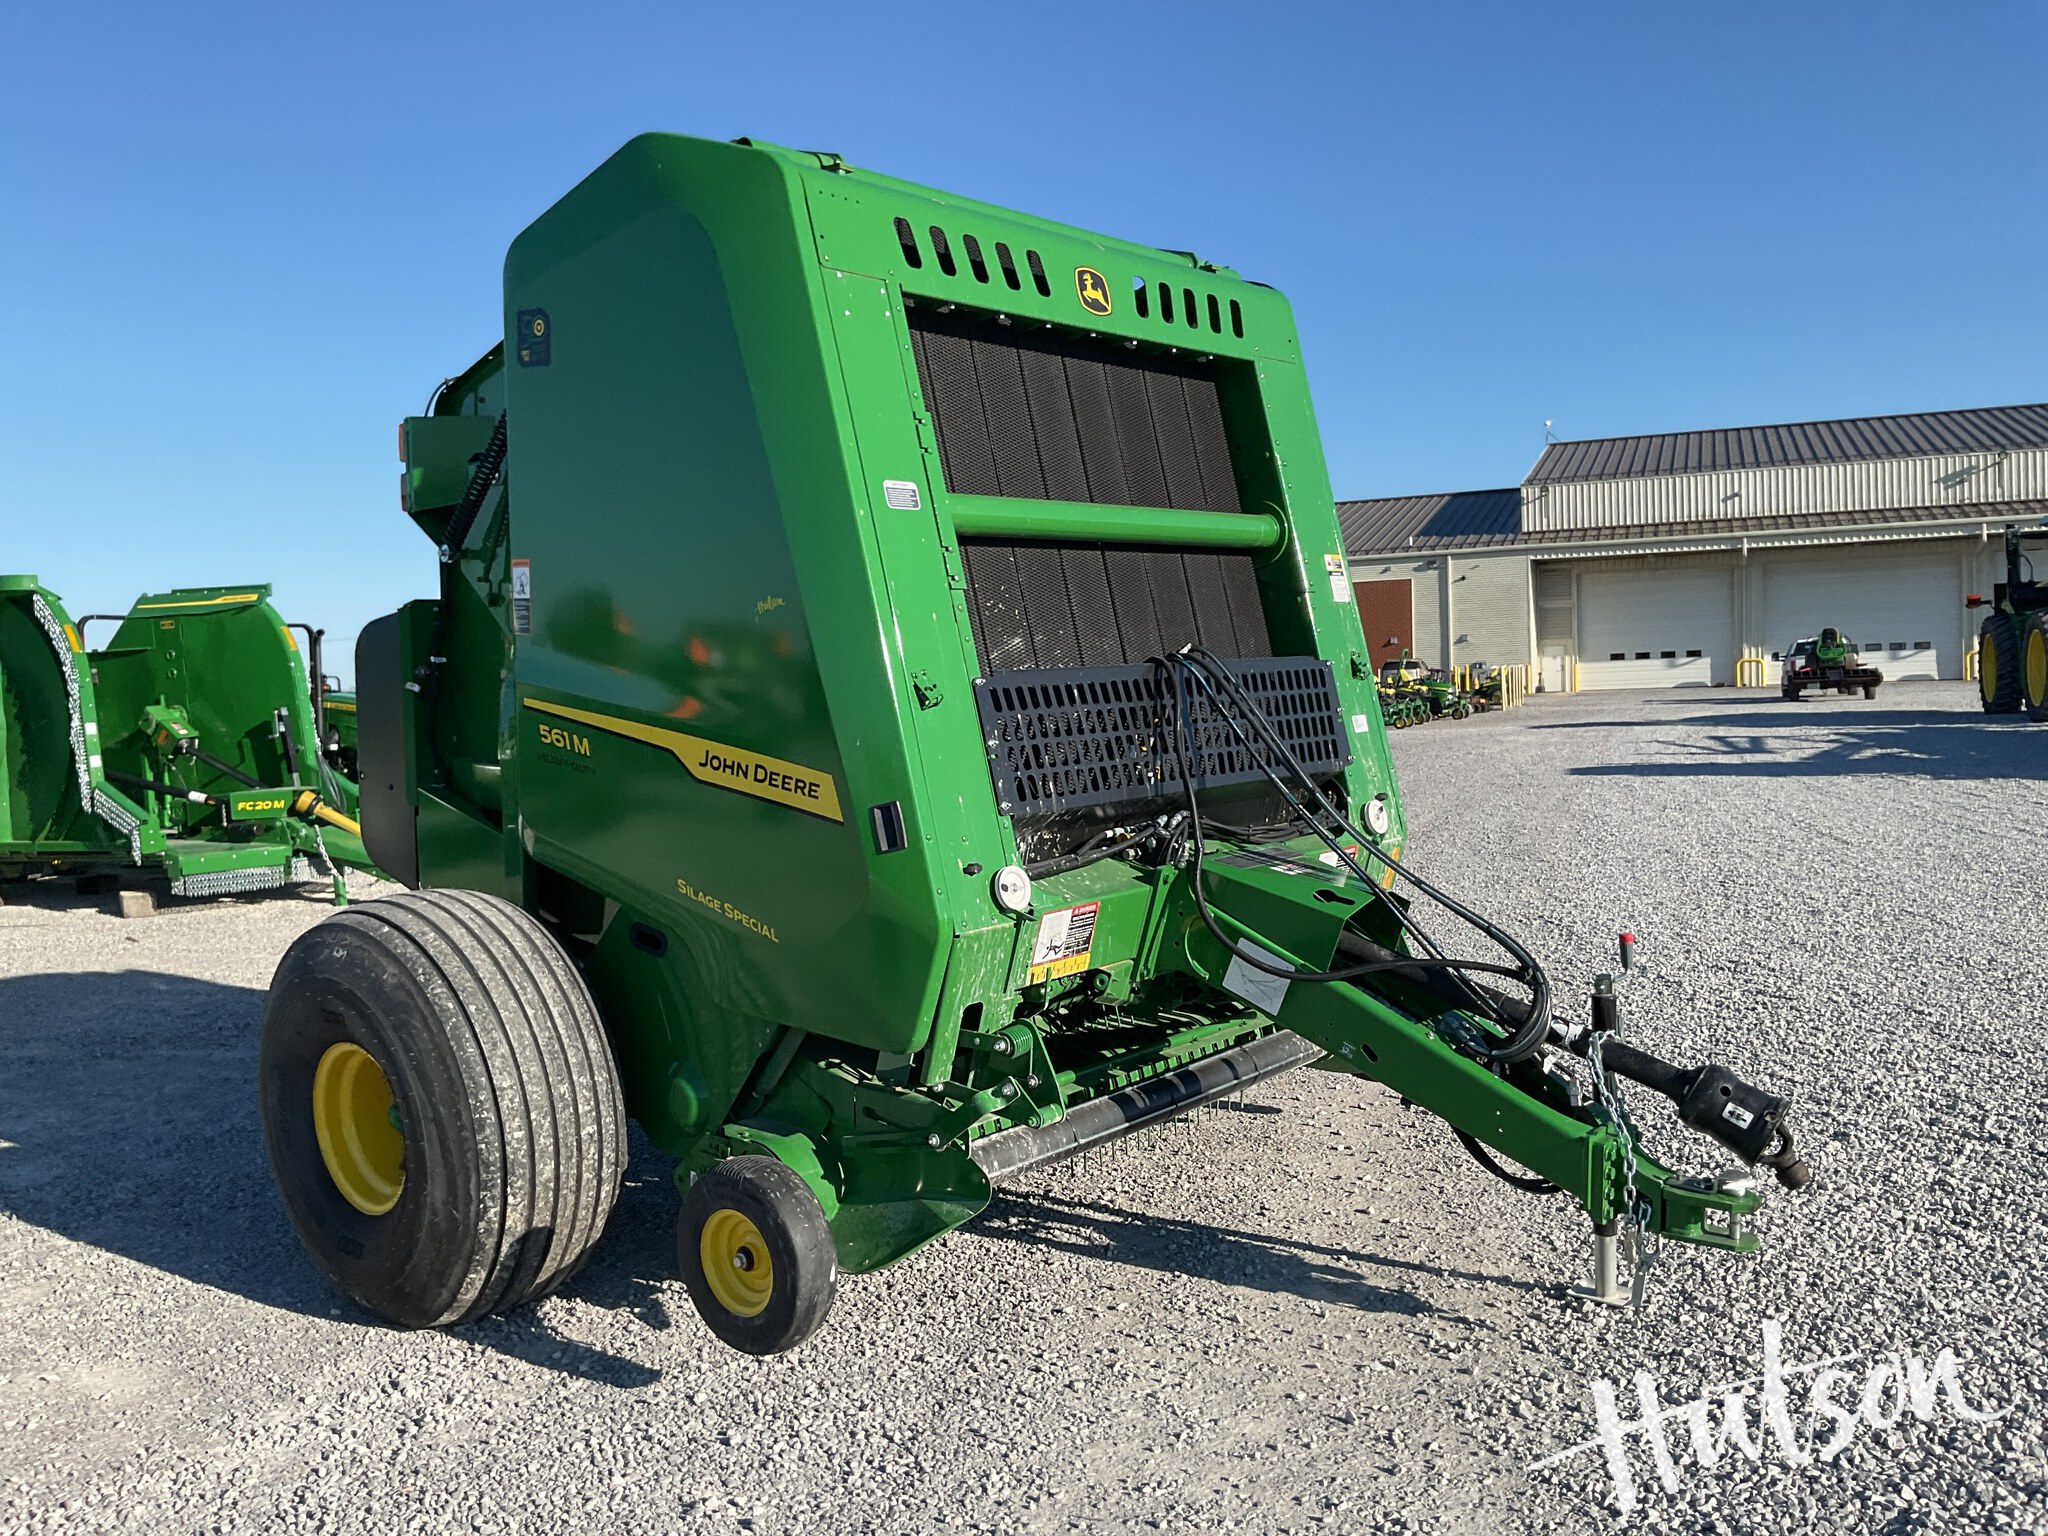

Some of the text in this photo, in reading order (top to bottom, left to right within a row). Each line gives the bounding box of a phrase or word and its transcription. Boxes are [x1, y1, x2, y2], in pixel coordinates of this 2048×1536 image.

[699, 749, 821, 800] JOHN DEERE
[677, 878, 779, 943] SILAGE SPECIAL
